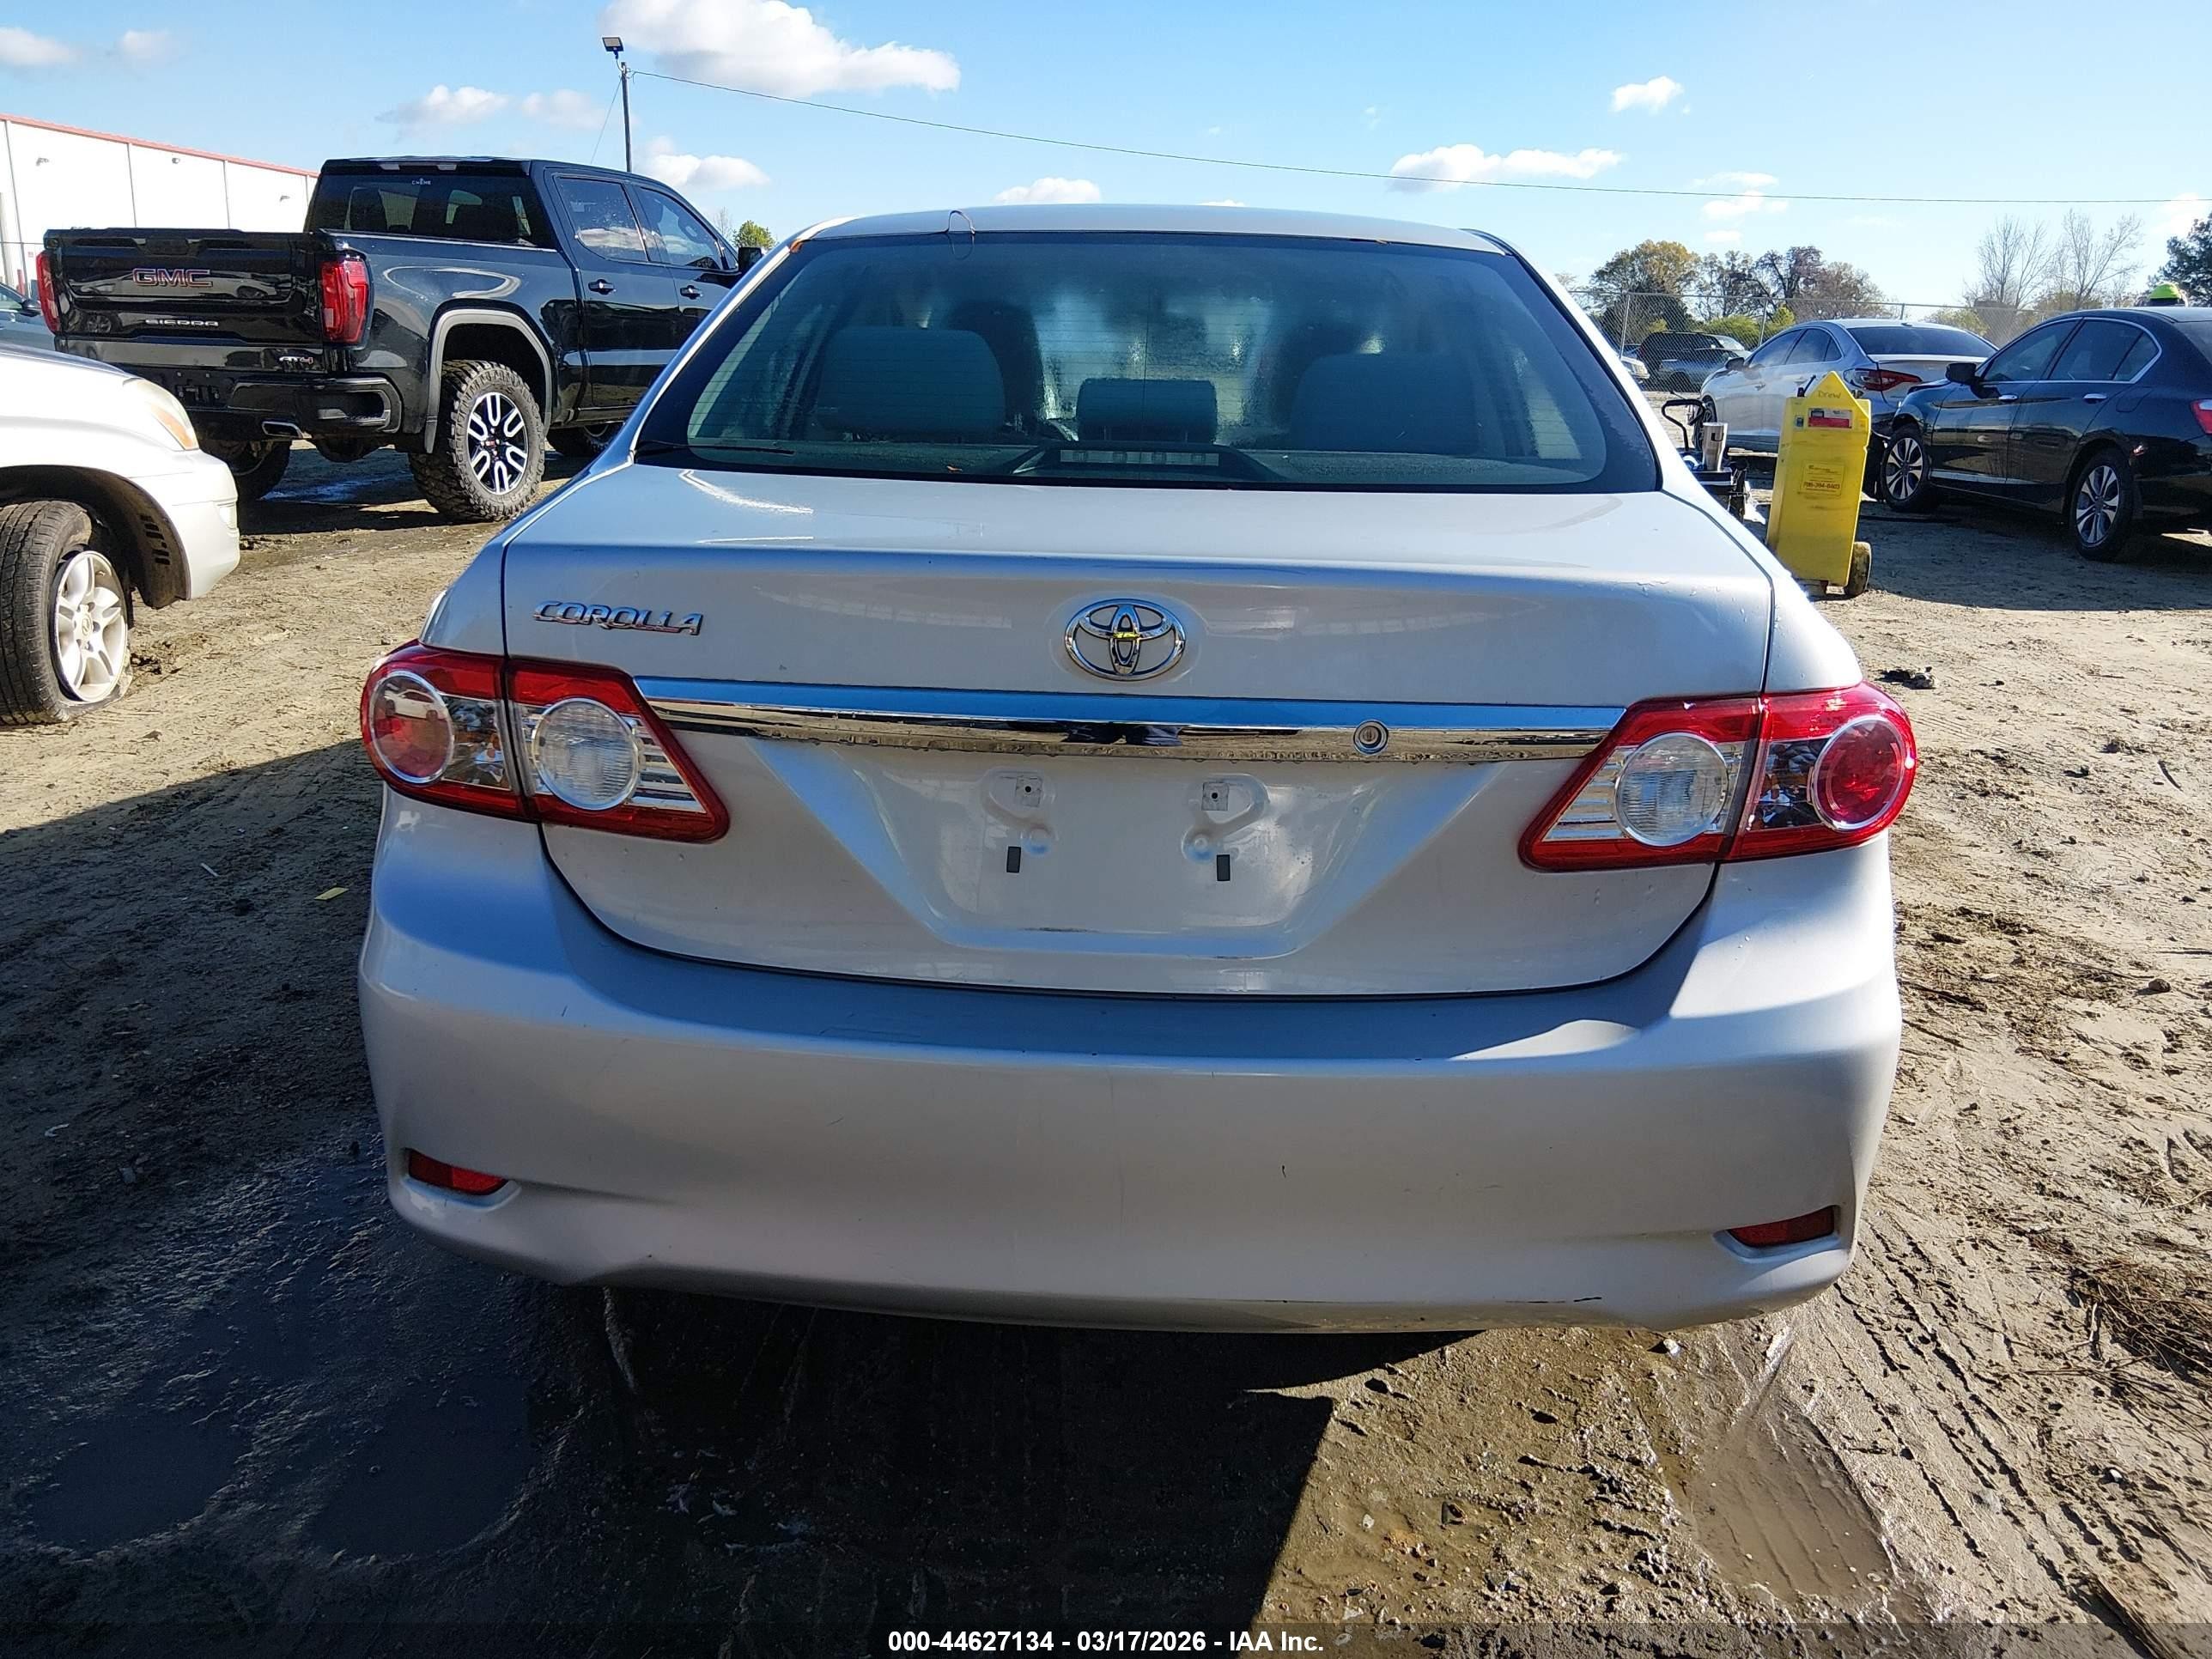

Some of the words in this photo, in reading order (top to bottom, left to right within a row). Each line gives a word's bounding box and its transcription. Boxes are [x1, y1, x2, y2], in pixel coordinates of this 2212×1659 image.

[132, 268, 214, 288] GMC
[144, 319, 219, 327] SIERRA
[532, 600, 704, 636] COROLLA
